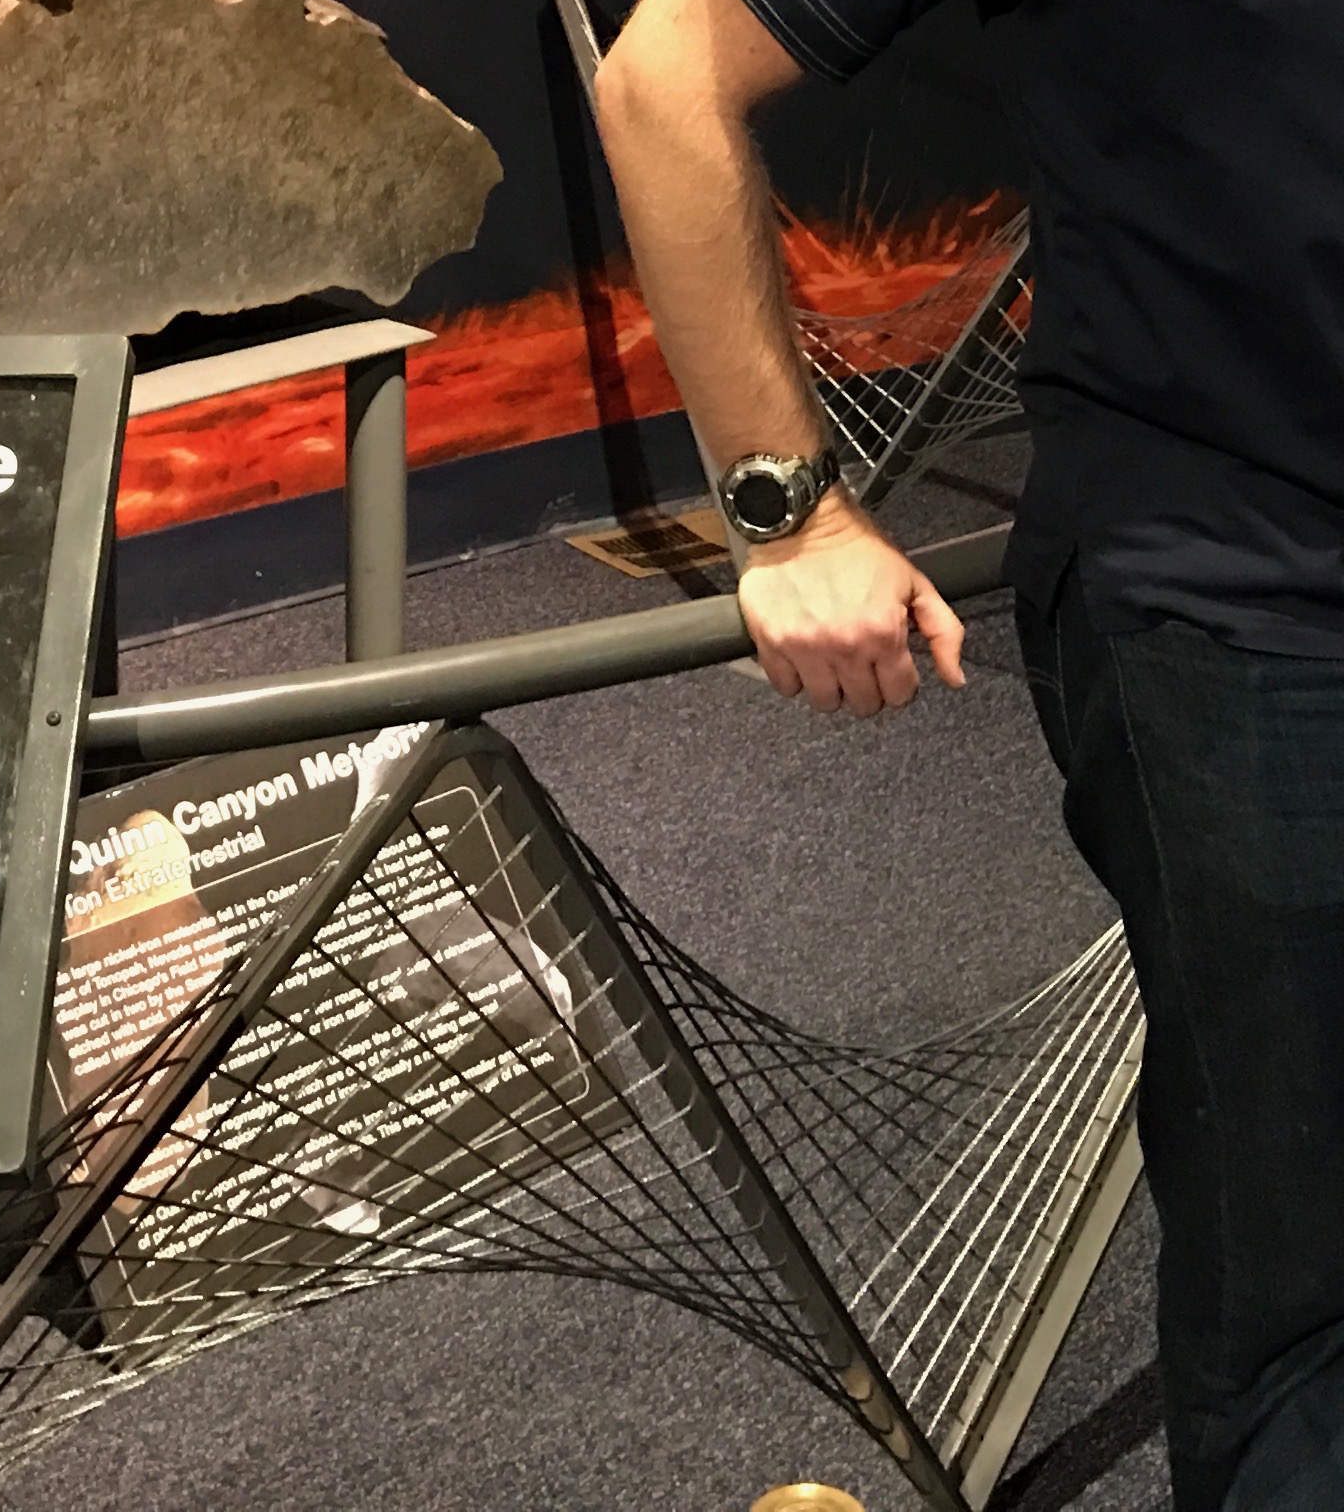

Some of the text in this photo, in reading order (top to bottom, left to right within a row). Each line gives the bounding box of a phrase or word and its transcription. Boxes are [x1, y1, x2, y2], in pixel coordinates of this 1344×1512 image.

[69, 819, 168, 875] Quinn
[173, 772, 299, 835] Canyon
[104, 825, 267, 903] Extraterrestrial
[147, 943, 192, 969] Nevada
[163, 916, 217, 944] meteorite
